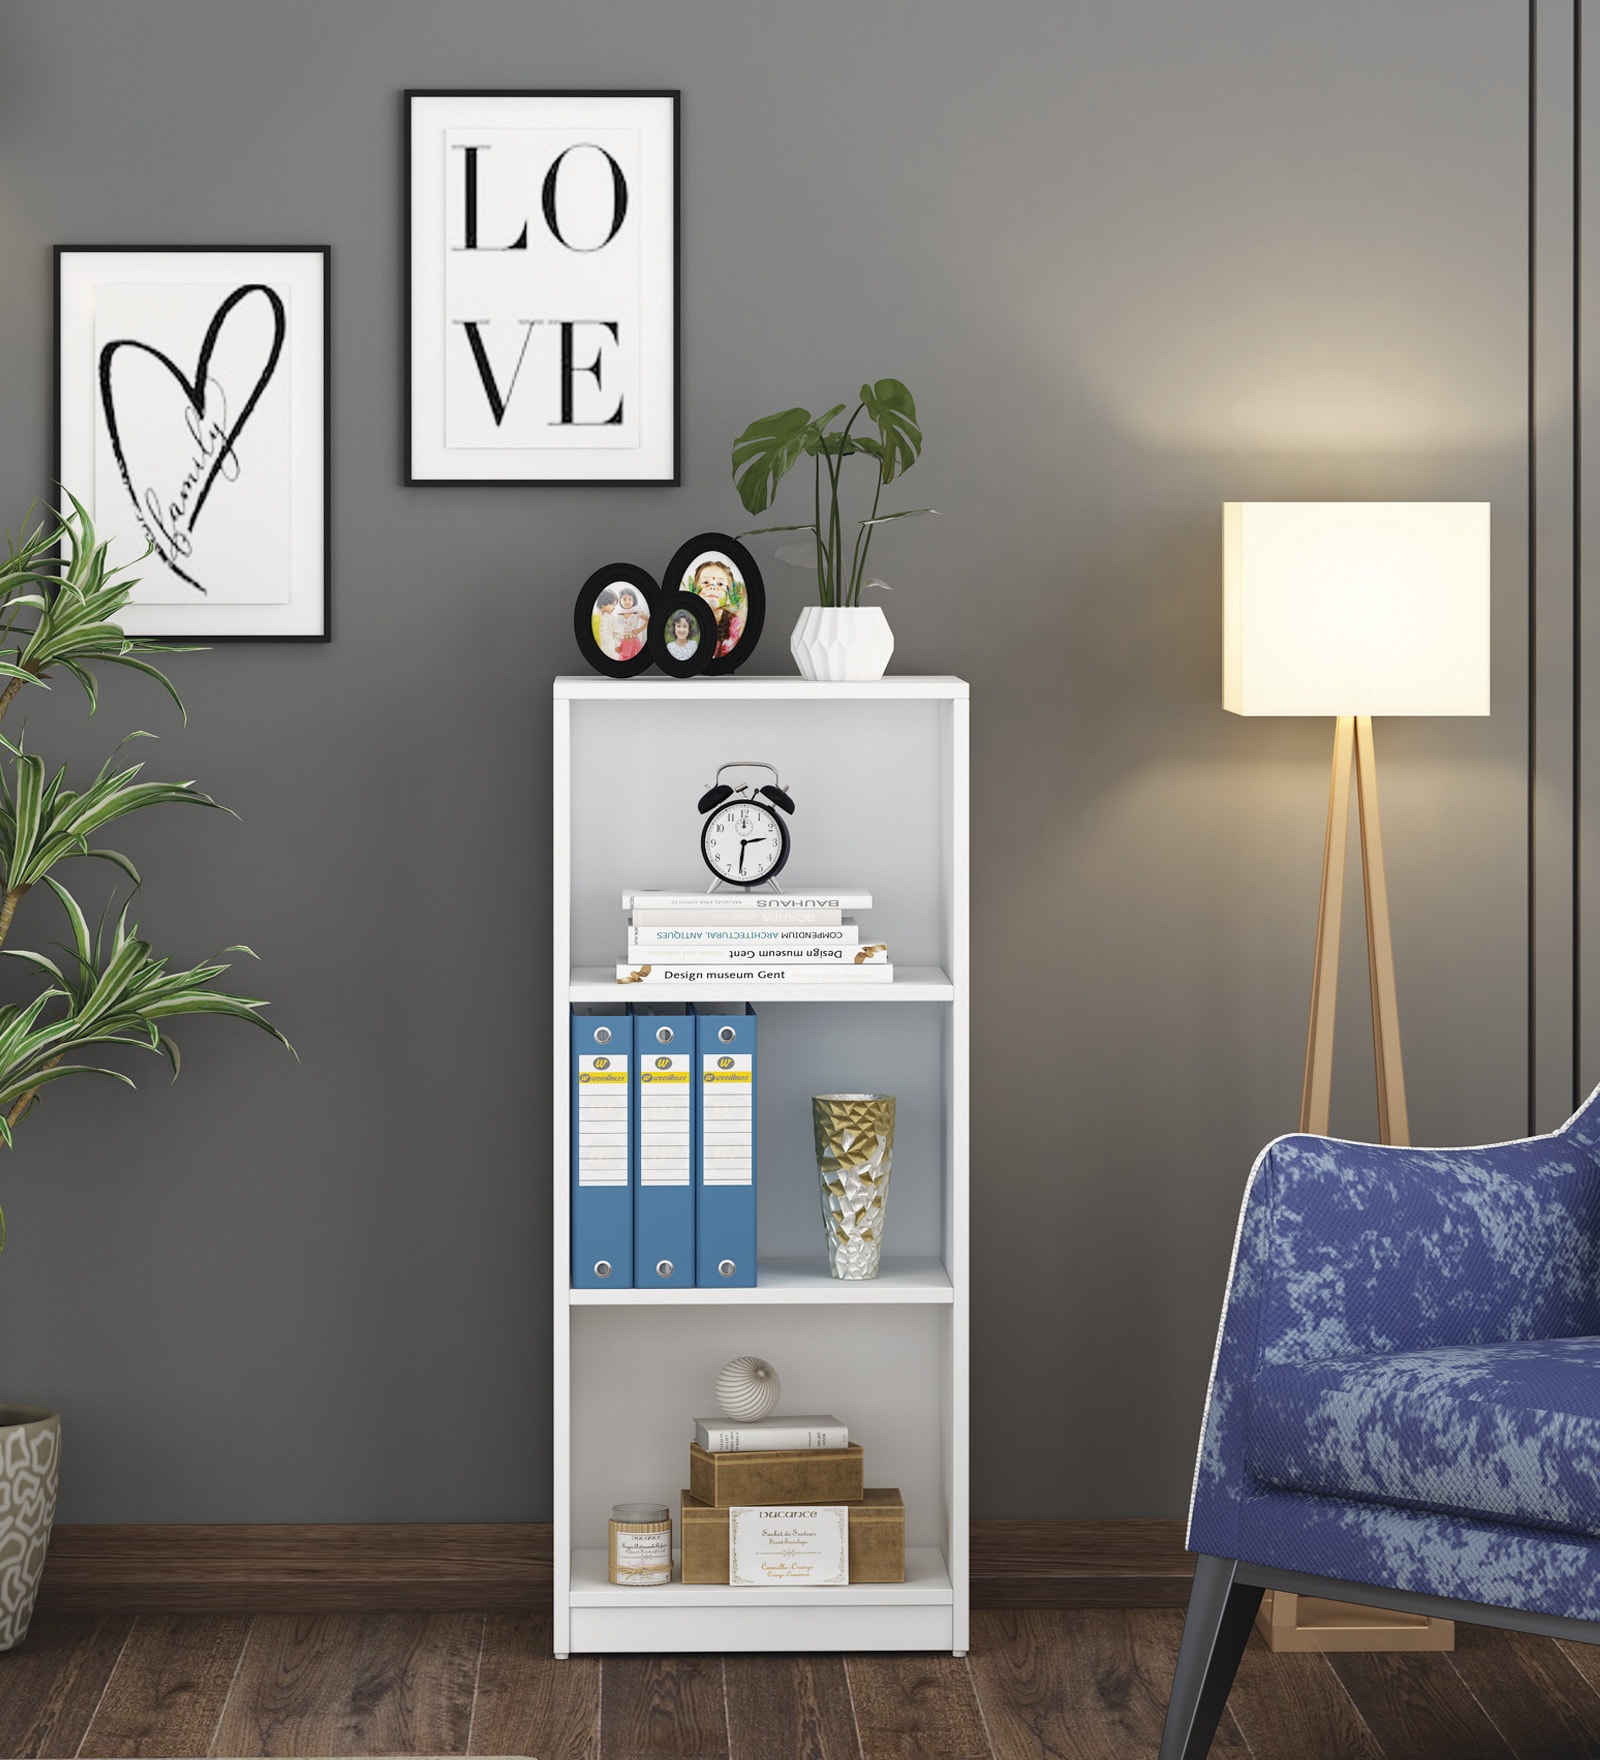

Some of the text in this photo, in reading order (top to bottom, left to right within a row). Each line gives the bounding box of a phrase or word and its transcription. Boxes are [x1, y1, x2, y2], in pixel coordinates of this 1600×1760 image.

[451, 142, 629, 253] LO
[452, 319, 626, 428] VE
[145, 376, 240, 563] family
[757, 899, 840, 908] BAUHAUS
[762, 913, 816, 923] SCARPA
[657, 931, 843, 939] COMPENDIUM ARCHITECTURAL ANTIQUES
[729, 950, 755, 959] Gent
[759, 950, 803, 958] museum
[806, 948, 843, 960] Design
[665, 971, 703, 981] Design
[707, 972, 753, 980] museum
[758, 971, 785, 980] Gent
